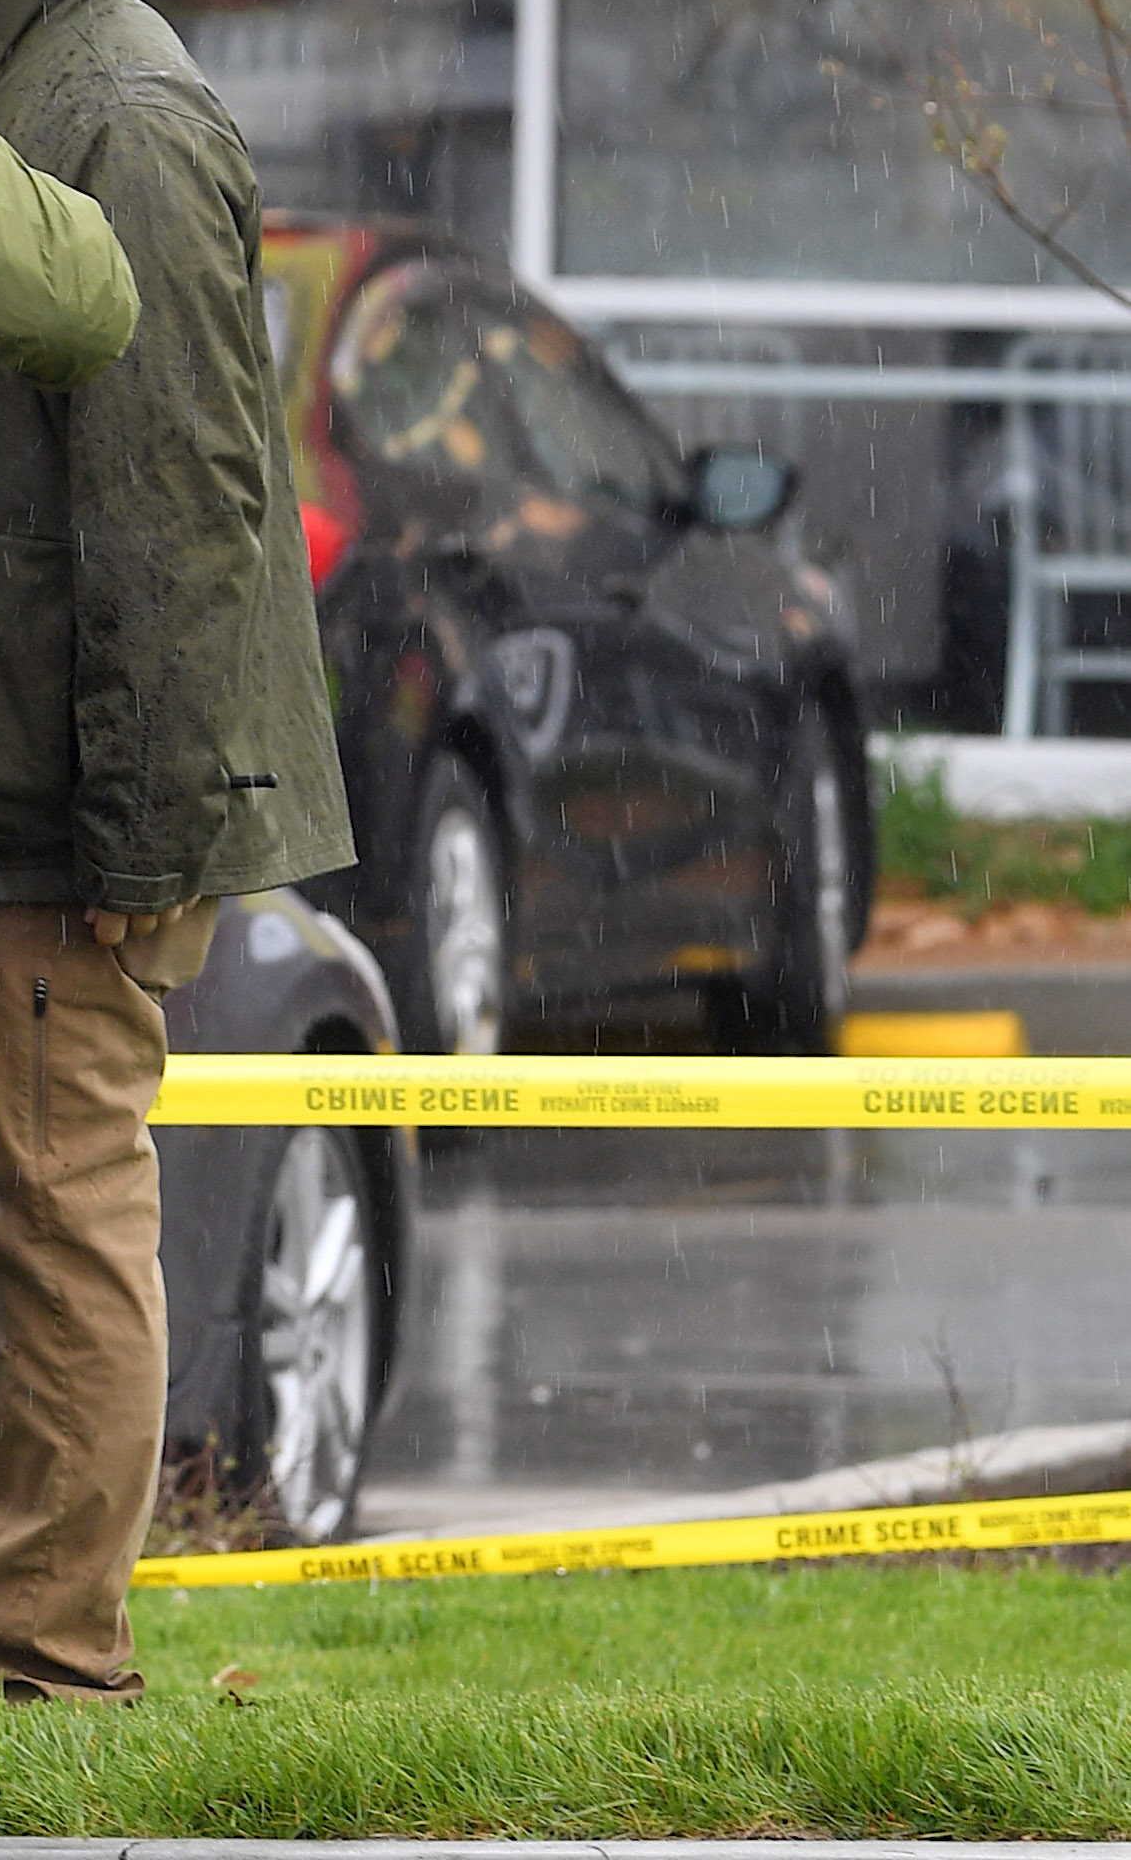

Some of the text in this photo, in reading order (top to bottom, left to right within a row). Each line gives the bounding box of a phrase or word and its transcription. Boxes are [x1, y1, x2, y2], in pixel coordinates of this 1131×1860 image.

[776, 1516, 960, 1549] CRIME SCENE
[300, 1549, 481, 1578] CRIME SCENE
